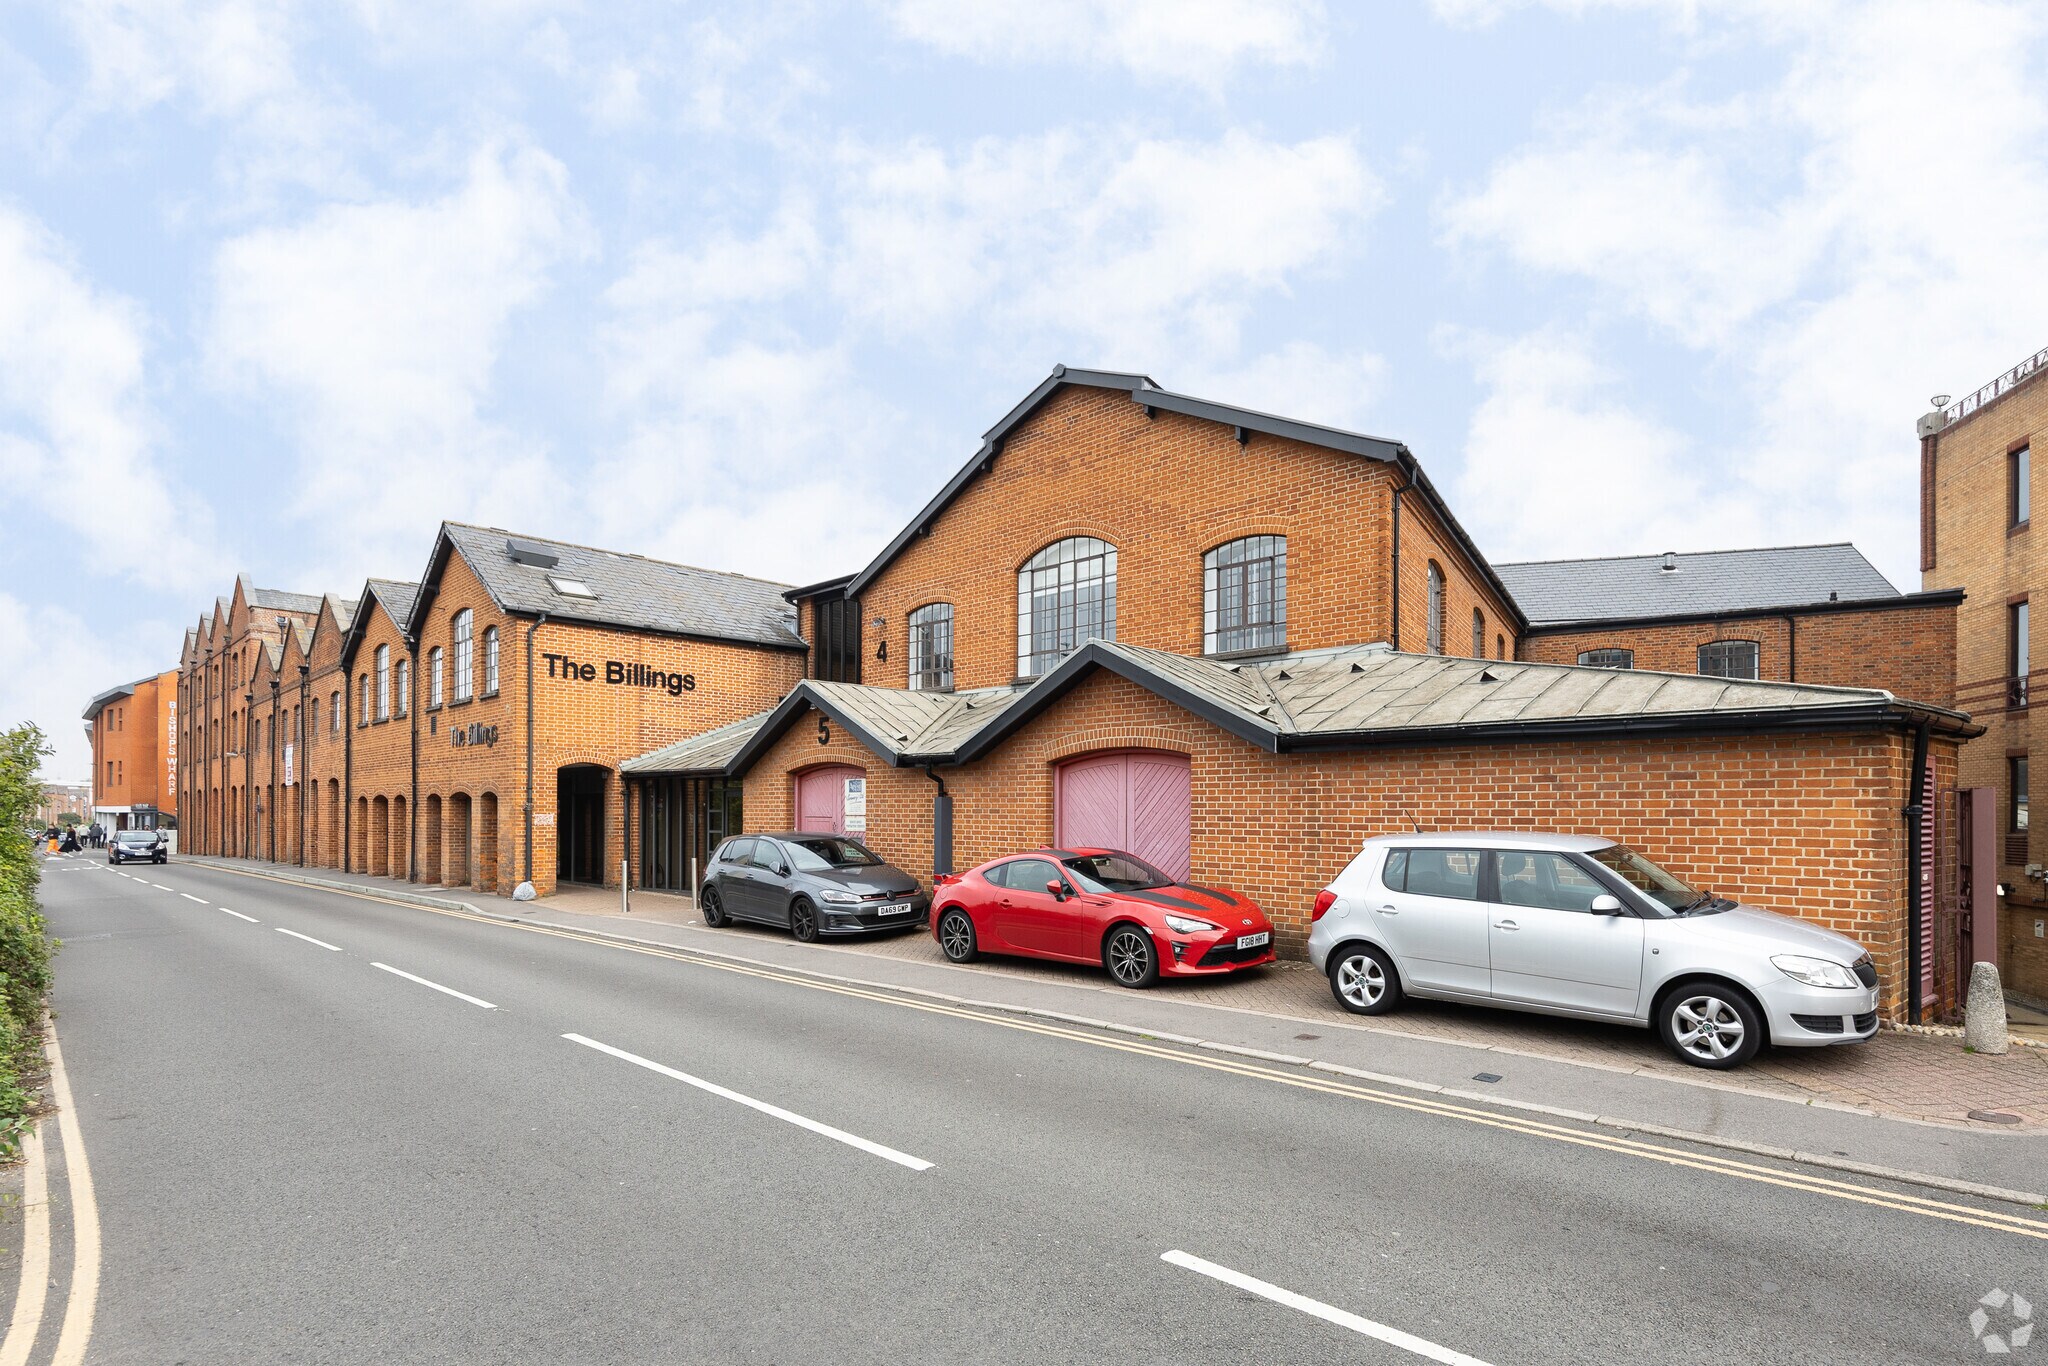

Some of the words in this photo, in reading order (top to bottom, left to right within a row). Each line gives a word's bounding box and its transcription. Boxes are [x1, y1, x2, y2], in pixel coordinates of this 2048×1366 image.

[876, 640, 888, 663] 4
[542, 653, 597, 682] The
[605, 660, 697, 697] Billings
[168, 701, 177, 755] BISHOPS
[449, 725, 466, 748] The
[467, 721, 499, 748] Billings
[818, 716, 830, 745] 5
[166, 757, 178, 796] WHARF
[880, 906, 897, 915] DA69
